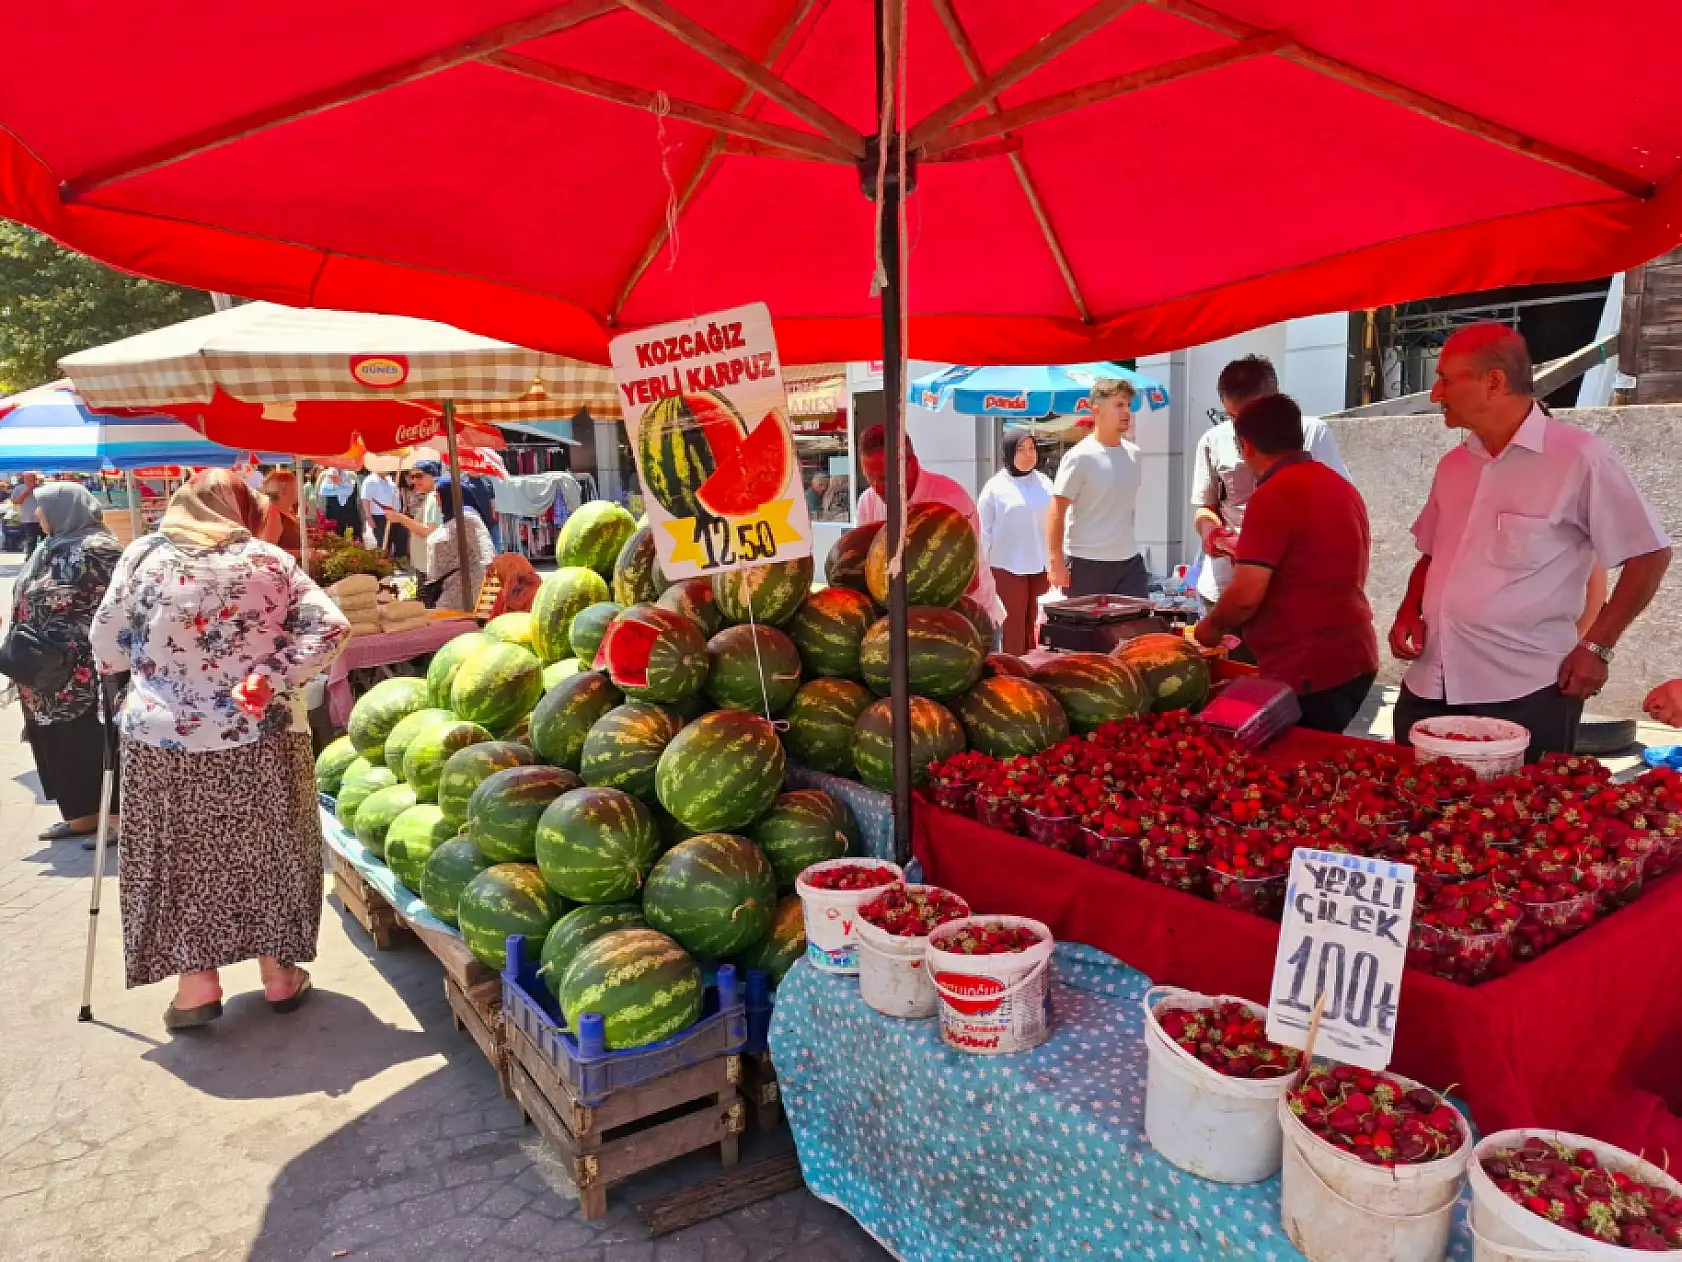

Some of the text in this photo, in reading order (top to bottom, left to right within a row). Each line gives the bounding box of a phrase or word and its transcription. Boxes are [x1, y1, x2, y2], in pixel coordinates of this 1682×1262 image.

[635, 321, 746, 369] KOZCAĞIZ
[686, 351, 776, 393] KARPUZ
[1304, 861, 1408, 910] YERLİ
[1294, 891, 1405, 948] ÇİLEK
